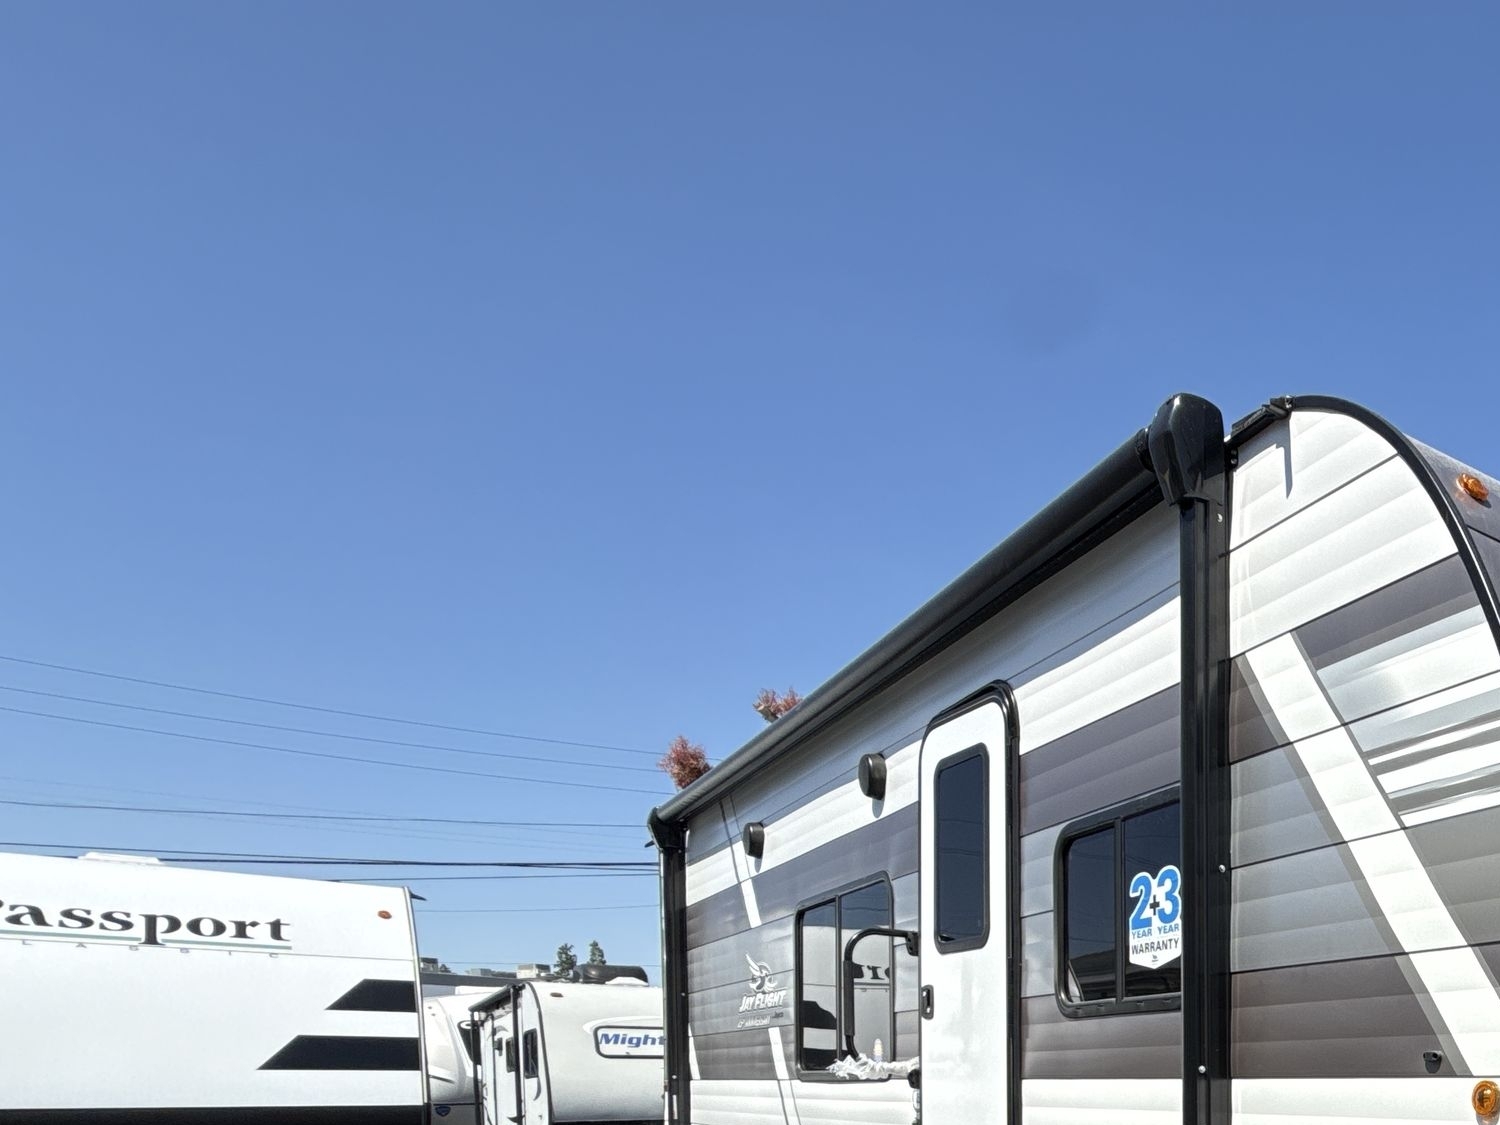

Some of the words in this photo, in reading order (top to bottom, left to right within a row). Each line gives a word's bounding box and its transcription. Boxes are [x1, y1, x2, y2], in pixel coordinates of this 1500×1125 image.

[0, 900, 291, 946] assport
[1132, 928, 1153, 940] YEAR
[1157, 923, 1180, 936] YEAR
[1131, 938, 1180, 955] WARRANTY
[754, 990, 787, 1010] FLIGHT
